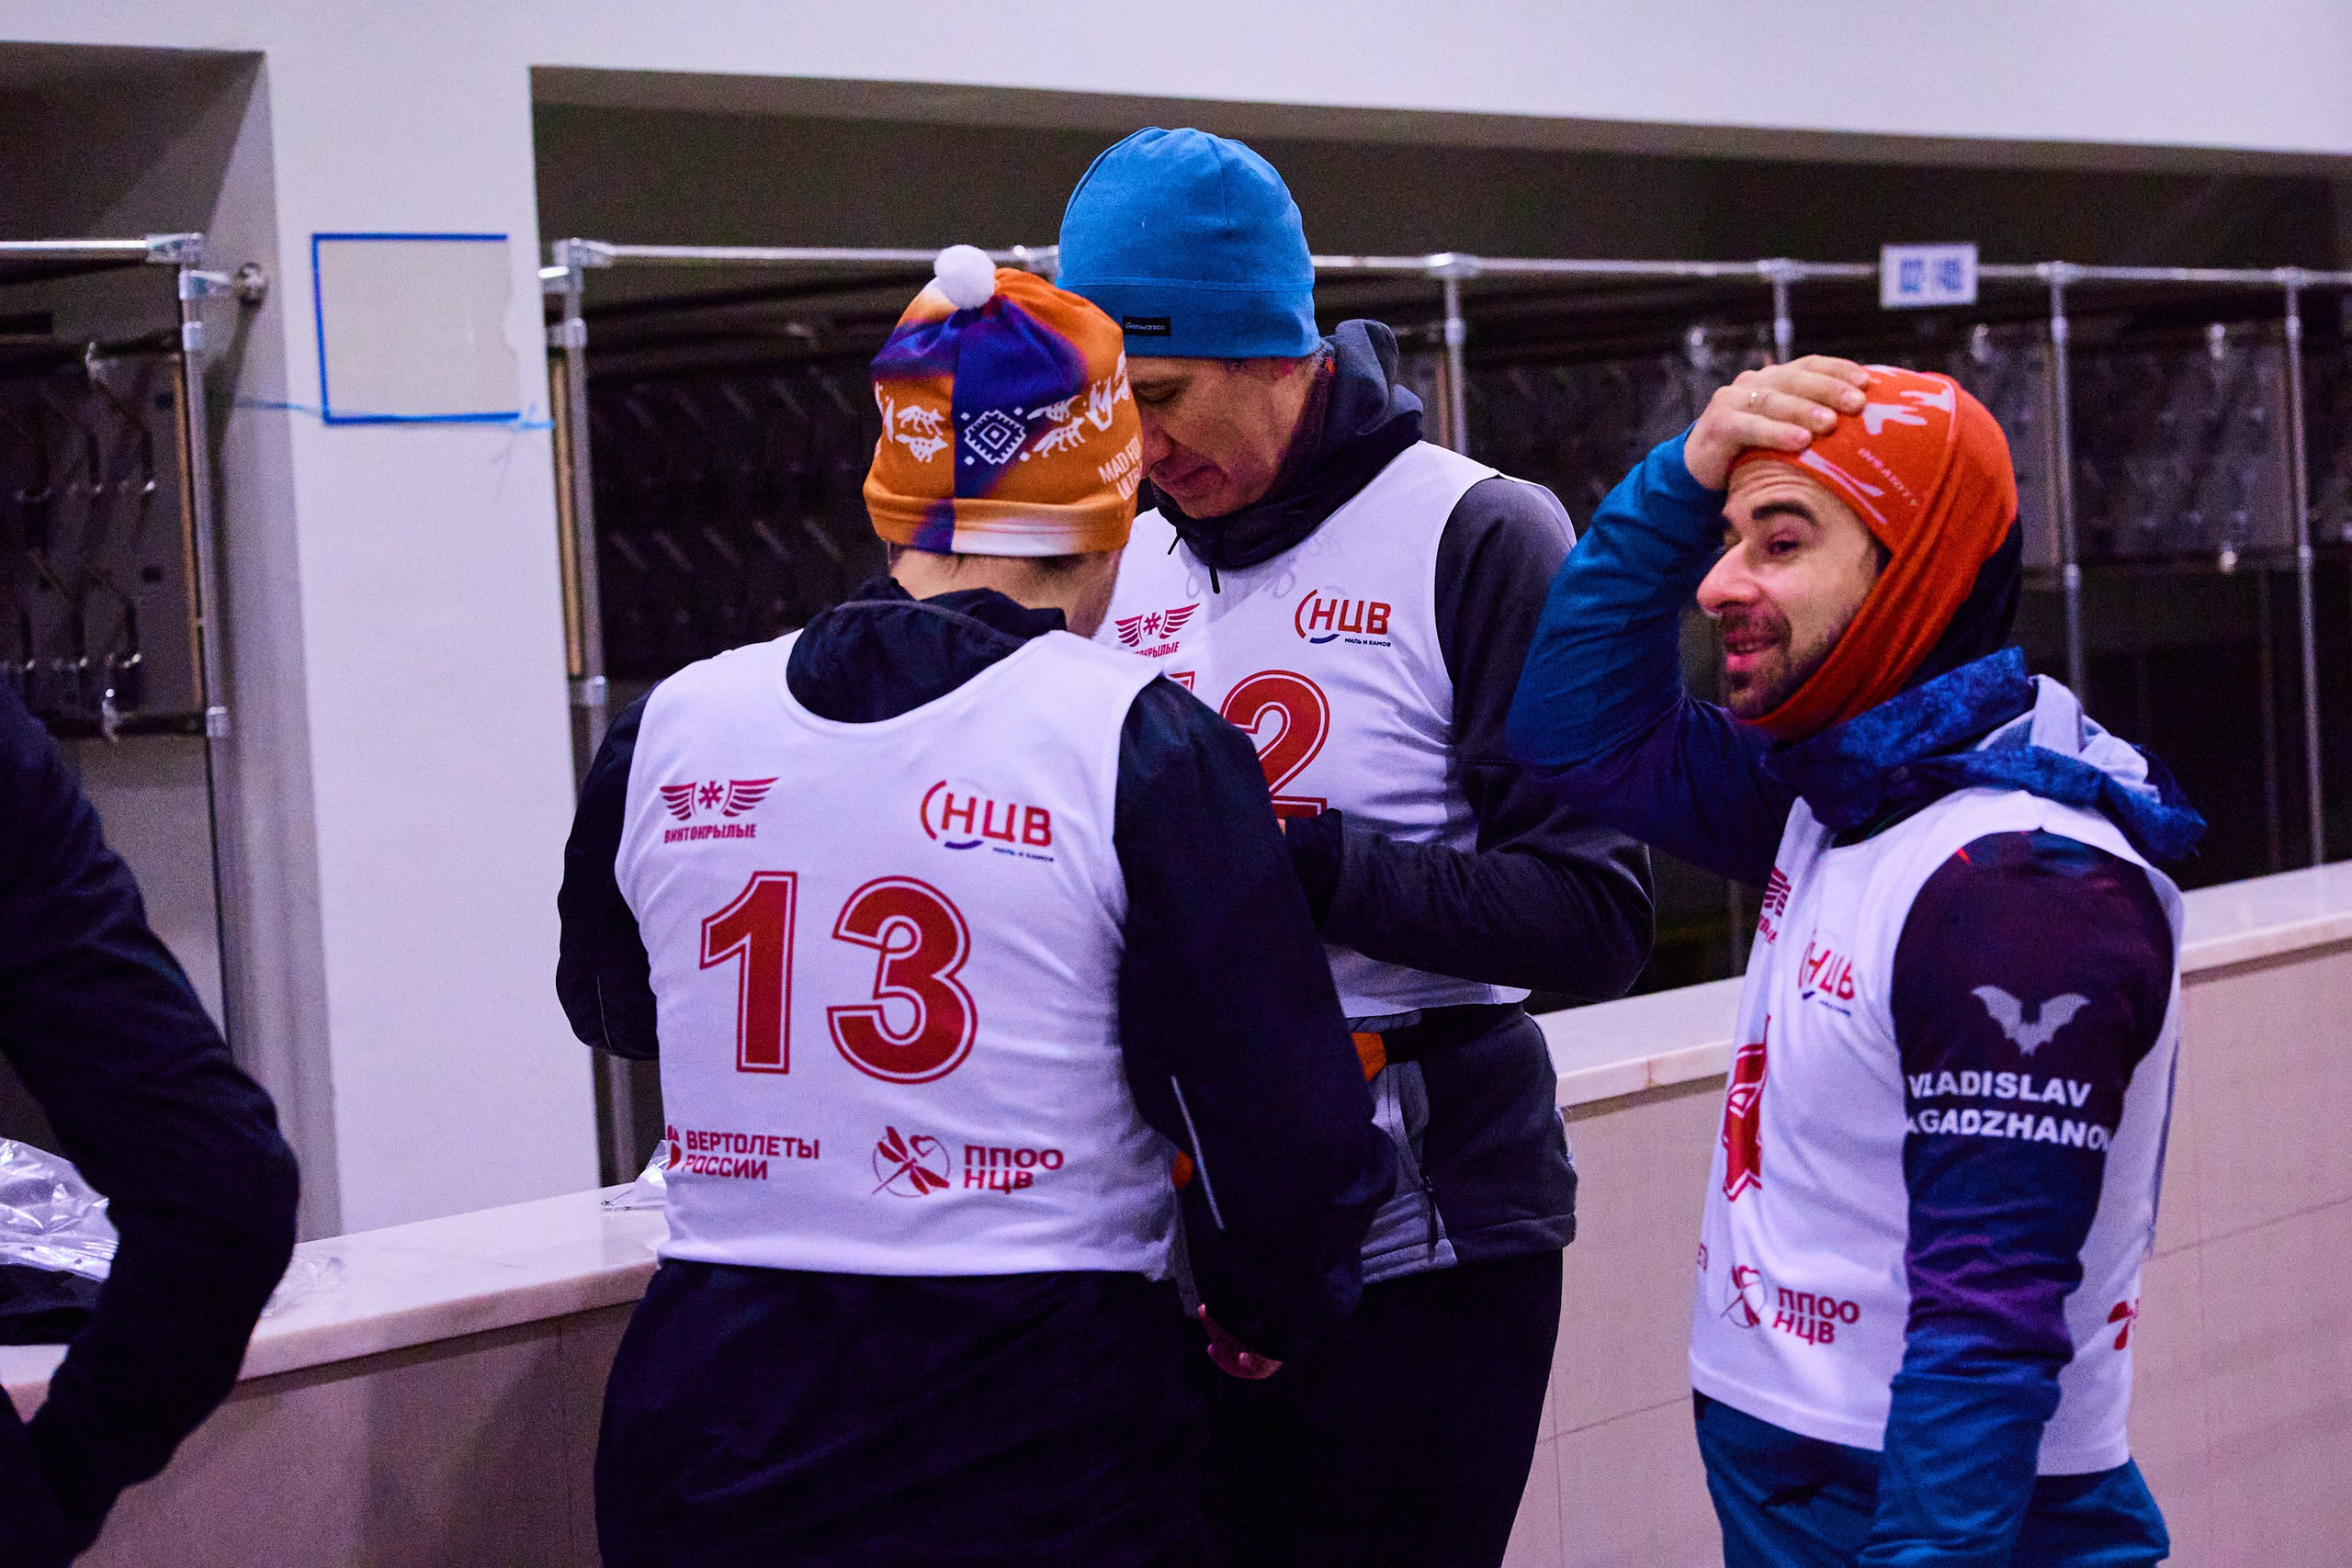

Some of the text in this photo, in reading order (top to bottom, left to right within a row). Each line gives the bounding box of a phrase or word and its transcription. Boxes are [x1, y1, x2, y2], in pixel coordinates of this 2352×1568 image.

[1098, 452, 1130, 485] MAD
[1308, 598, 1391, 635] НЦВ
[941, 793, 1052, 847] НЦВ
[699, 871, 978, 1084] 13
[1907, 1070, 2092, 1108] VLADISLAV
[686, 1130, 820, 1159] ВЕРТОЛЕТЫ
[965, 1145, 1064, 1170] ППОО
[682, 1154, 768, 1180] РОССИИ
[964, 1168, 1034, 1195] НЦВ
[1778, 1287, 1860, 1324] ППОО
[1772, 1311, 1835, 1345] НЦВ
